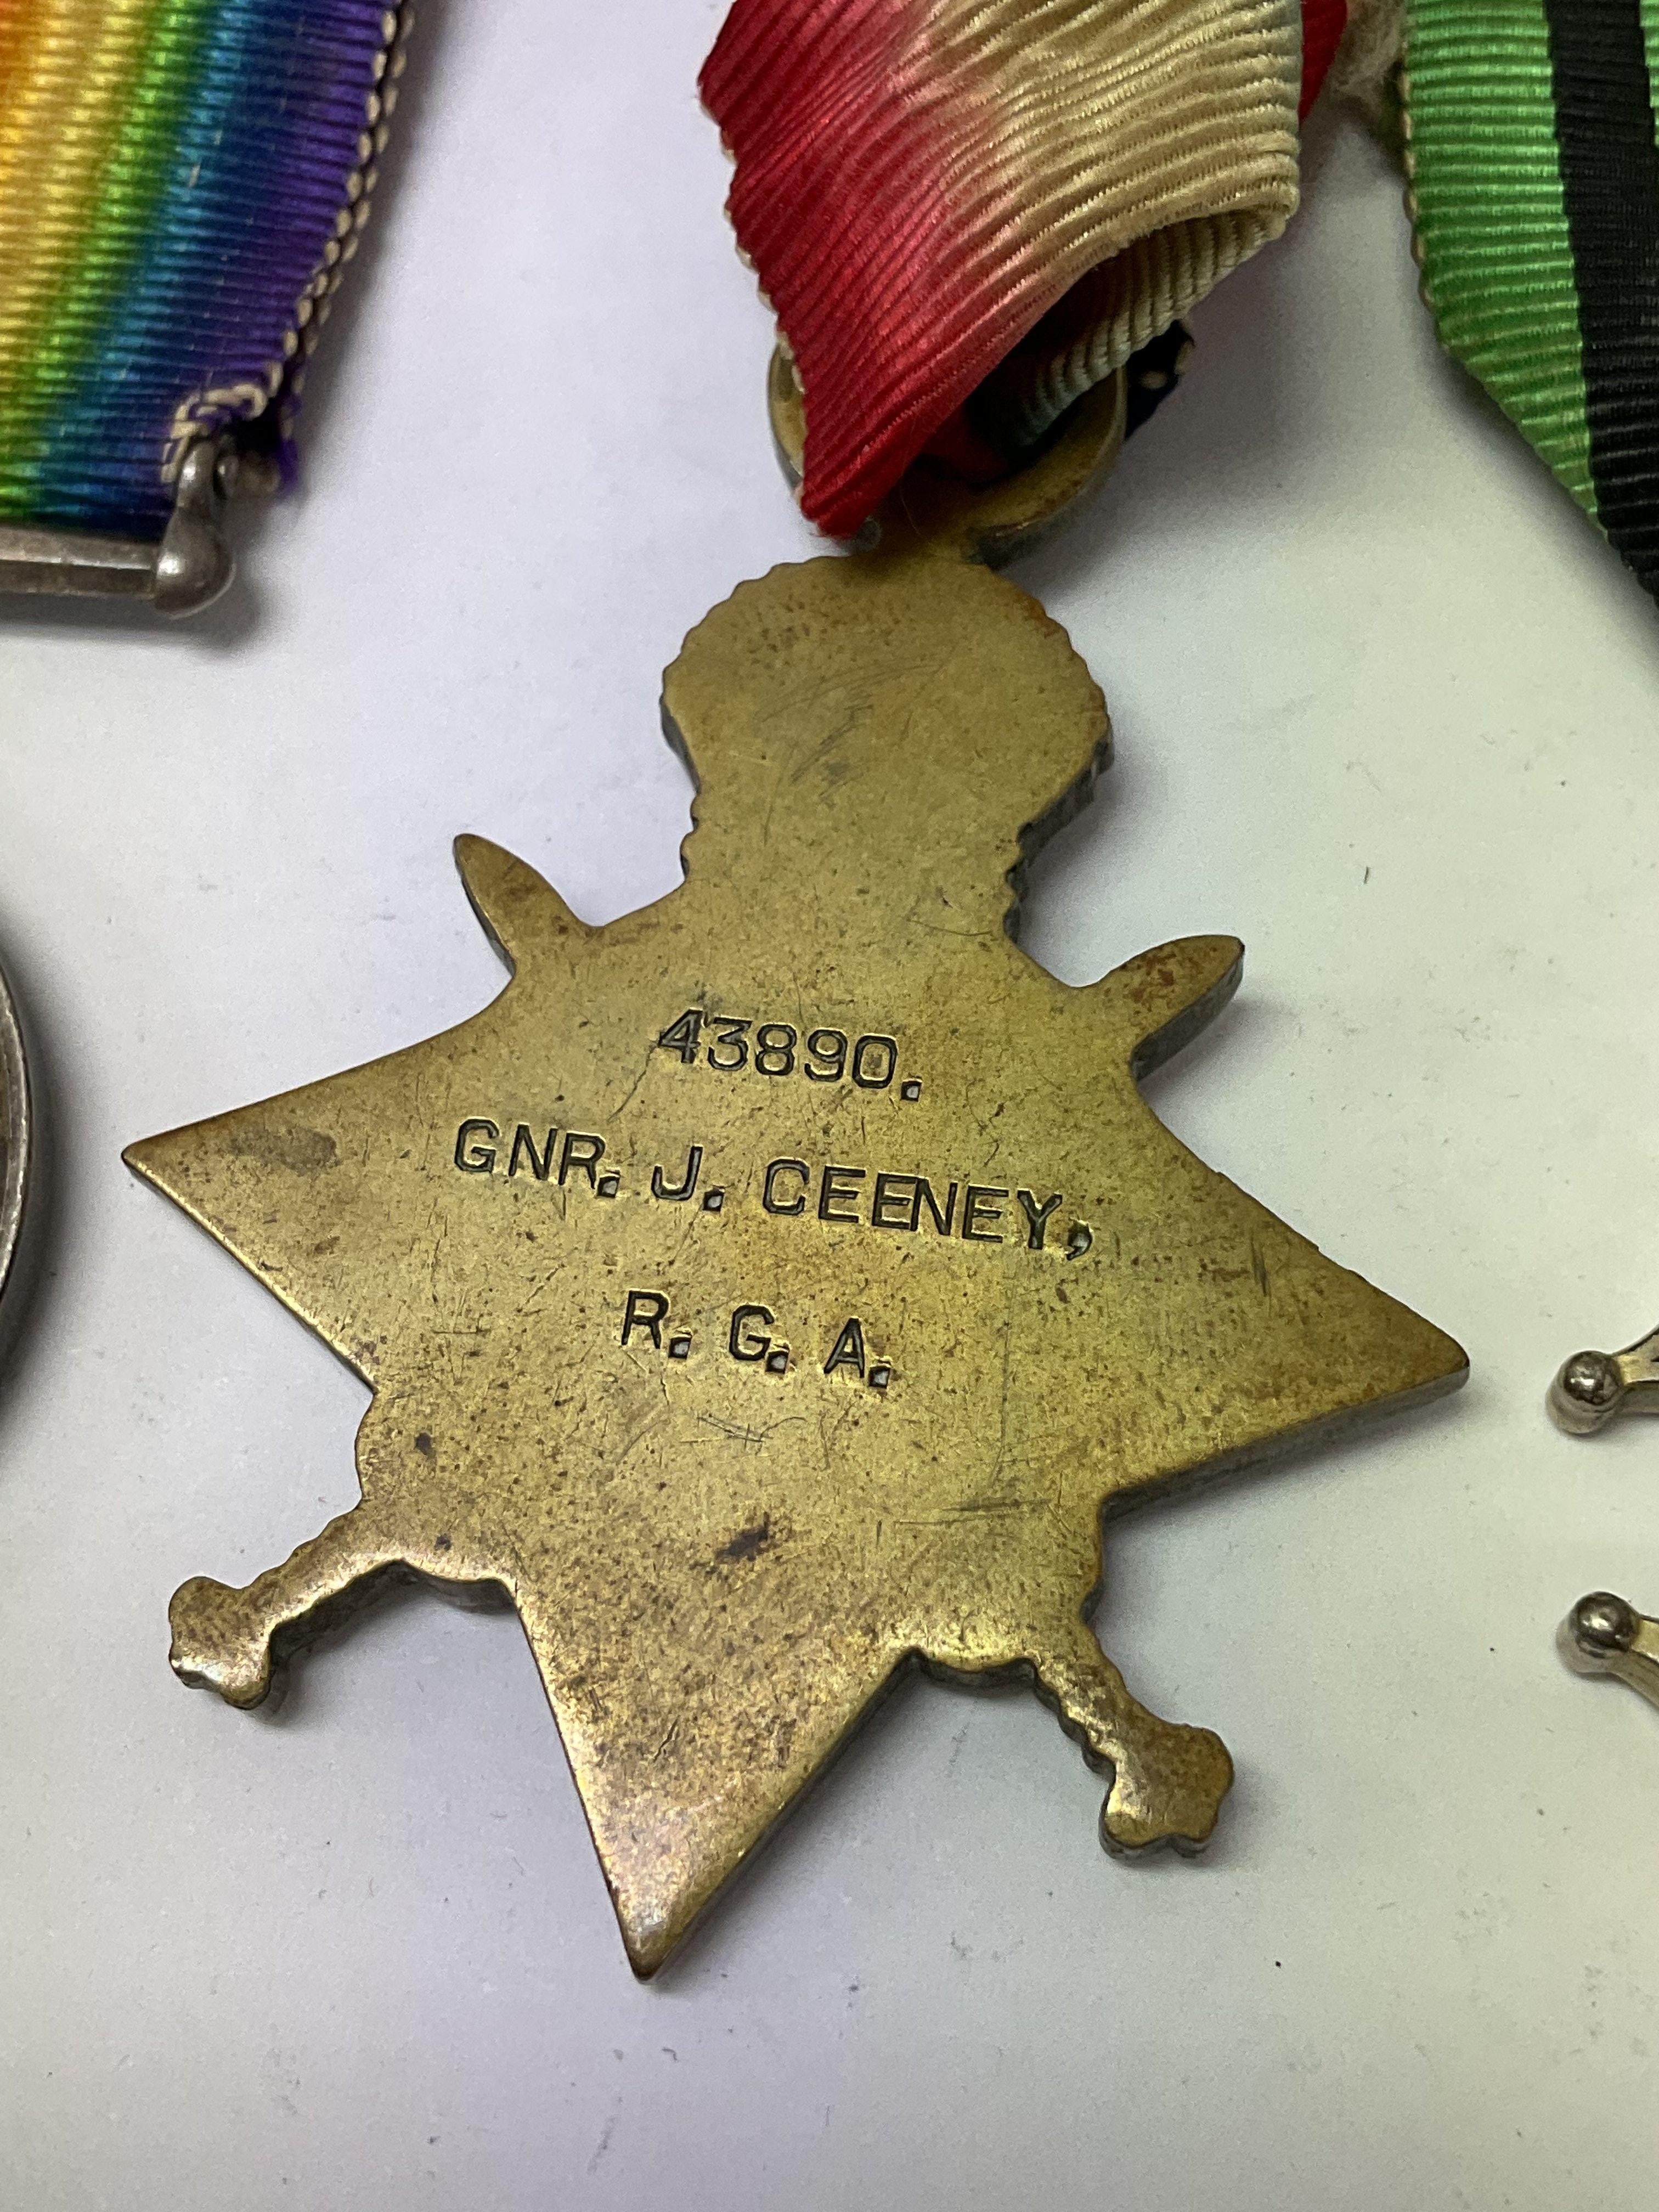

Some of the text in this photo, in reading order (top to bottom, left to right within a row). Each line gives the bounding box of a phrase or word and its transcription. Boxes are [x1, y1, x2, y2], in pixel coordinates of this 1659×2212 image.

[658, 1007, 921, 1101] 43890.
[453, 1118, 1093, 1261] GNR. J. CEENEY,
[621, 1290, 891, 1388] R. G. A.
